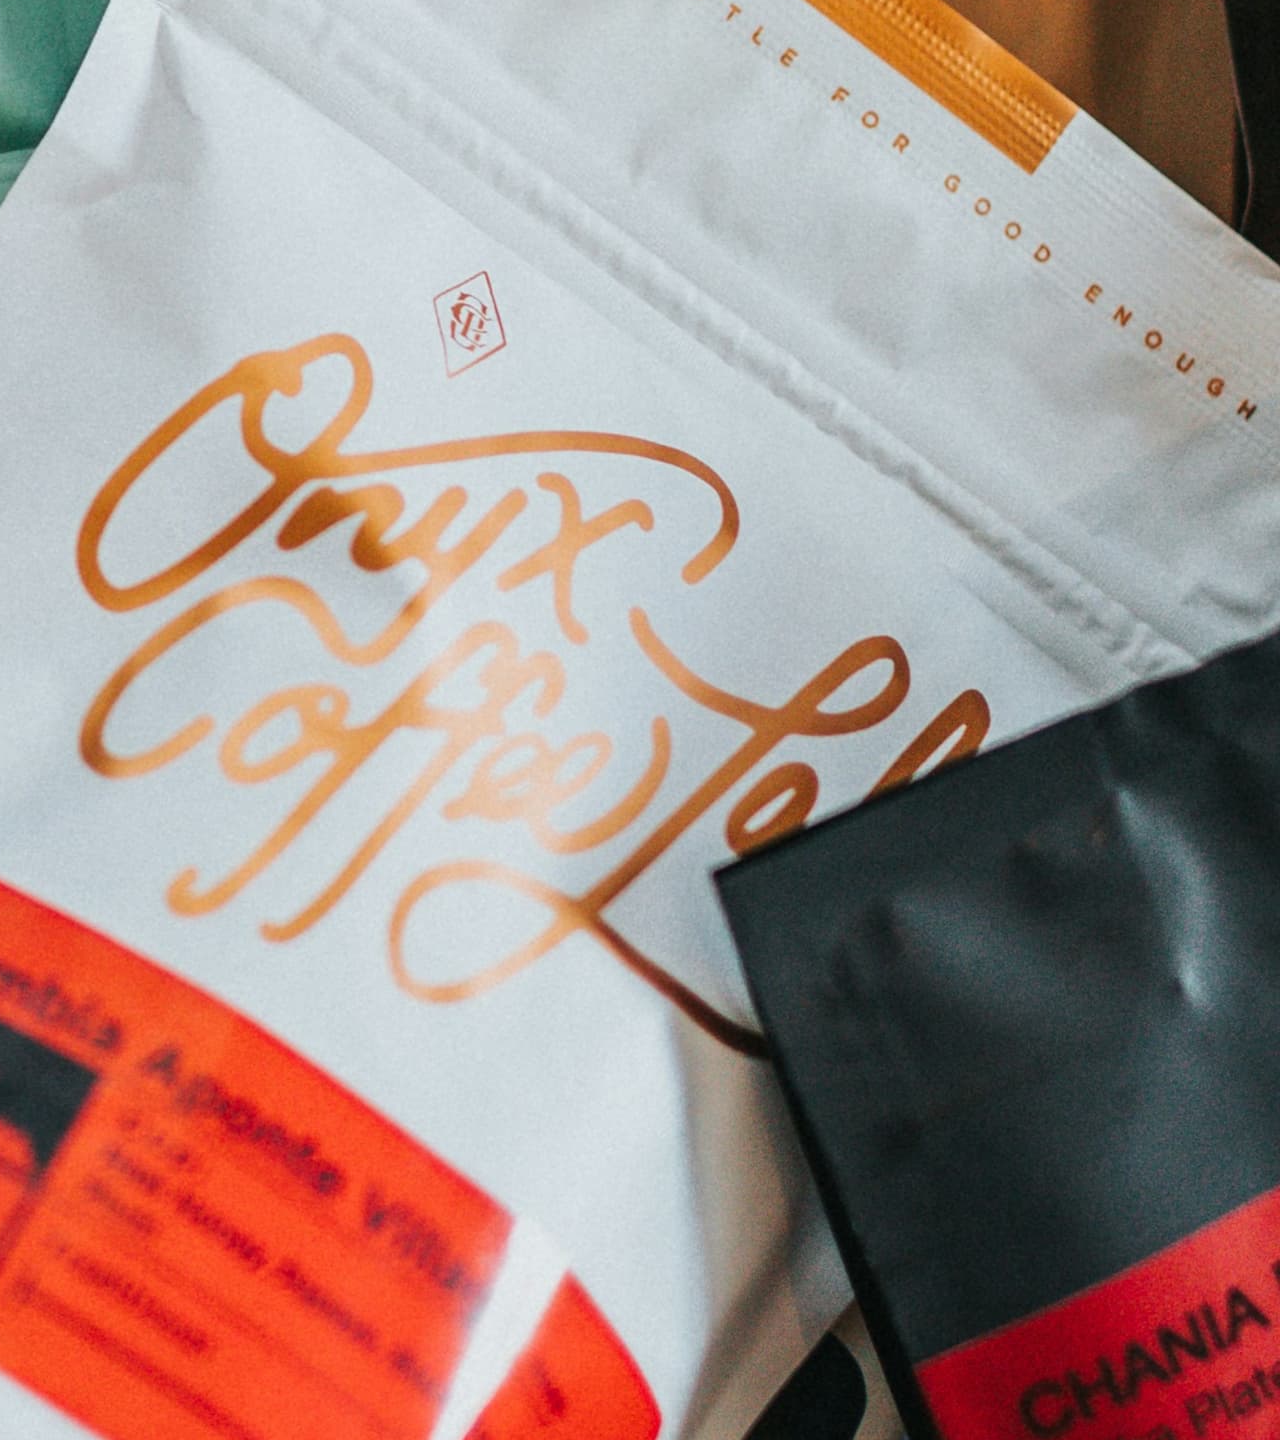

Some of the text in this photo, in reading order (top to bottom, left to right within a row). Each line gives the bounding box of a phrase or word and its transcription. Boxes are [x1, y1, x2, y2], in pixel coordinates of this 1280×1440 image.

[831, 84, 913, 154] FOR
[942, 171, 1054, 266] GOOD
[1083, 283, 1260, 424] ENOUGH
[76, 332, 740, 665] Onyx
[77, 580, 672, 943] Coffee
[1018, 1283, 1272, 1440] CHANIA
